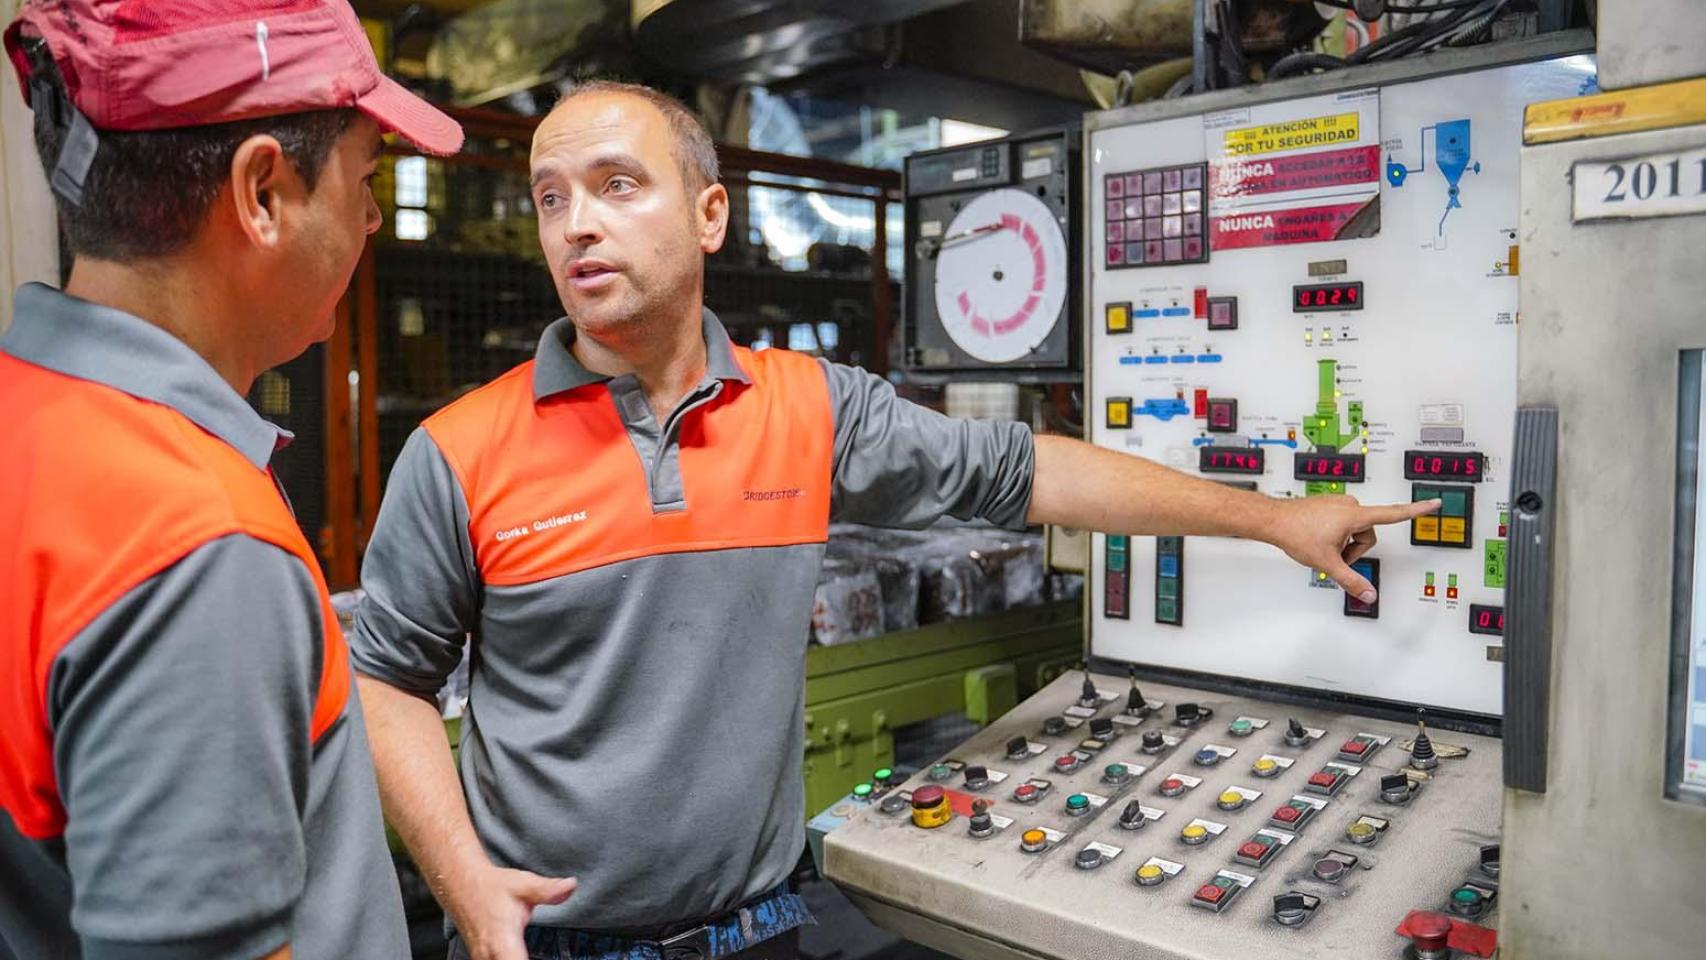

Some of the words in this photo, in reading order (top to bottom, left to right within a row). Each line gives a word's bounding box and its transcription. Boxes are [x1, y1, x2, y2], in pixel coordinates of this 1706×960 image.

[1257, 140, 1275, 150] TU
[1278, 128, 1356, 147] SEGURIDAD
[1219, 215, 1275, 233] NUNCA
[1307, 458, 1360, 476] 1021
